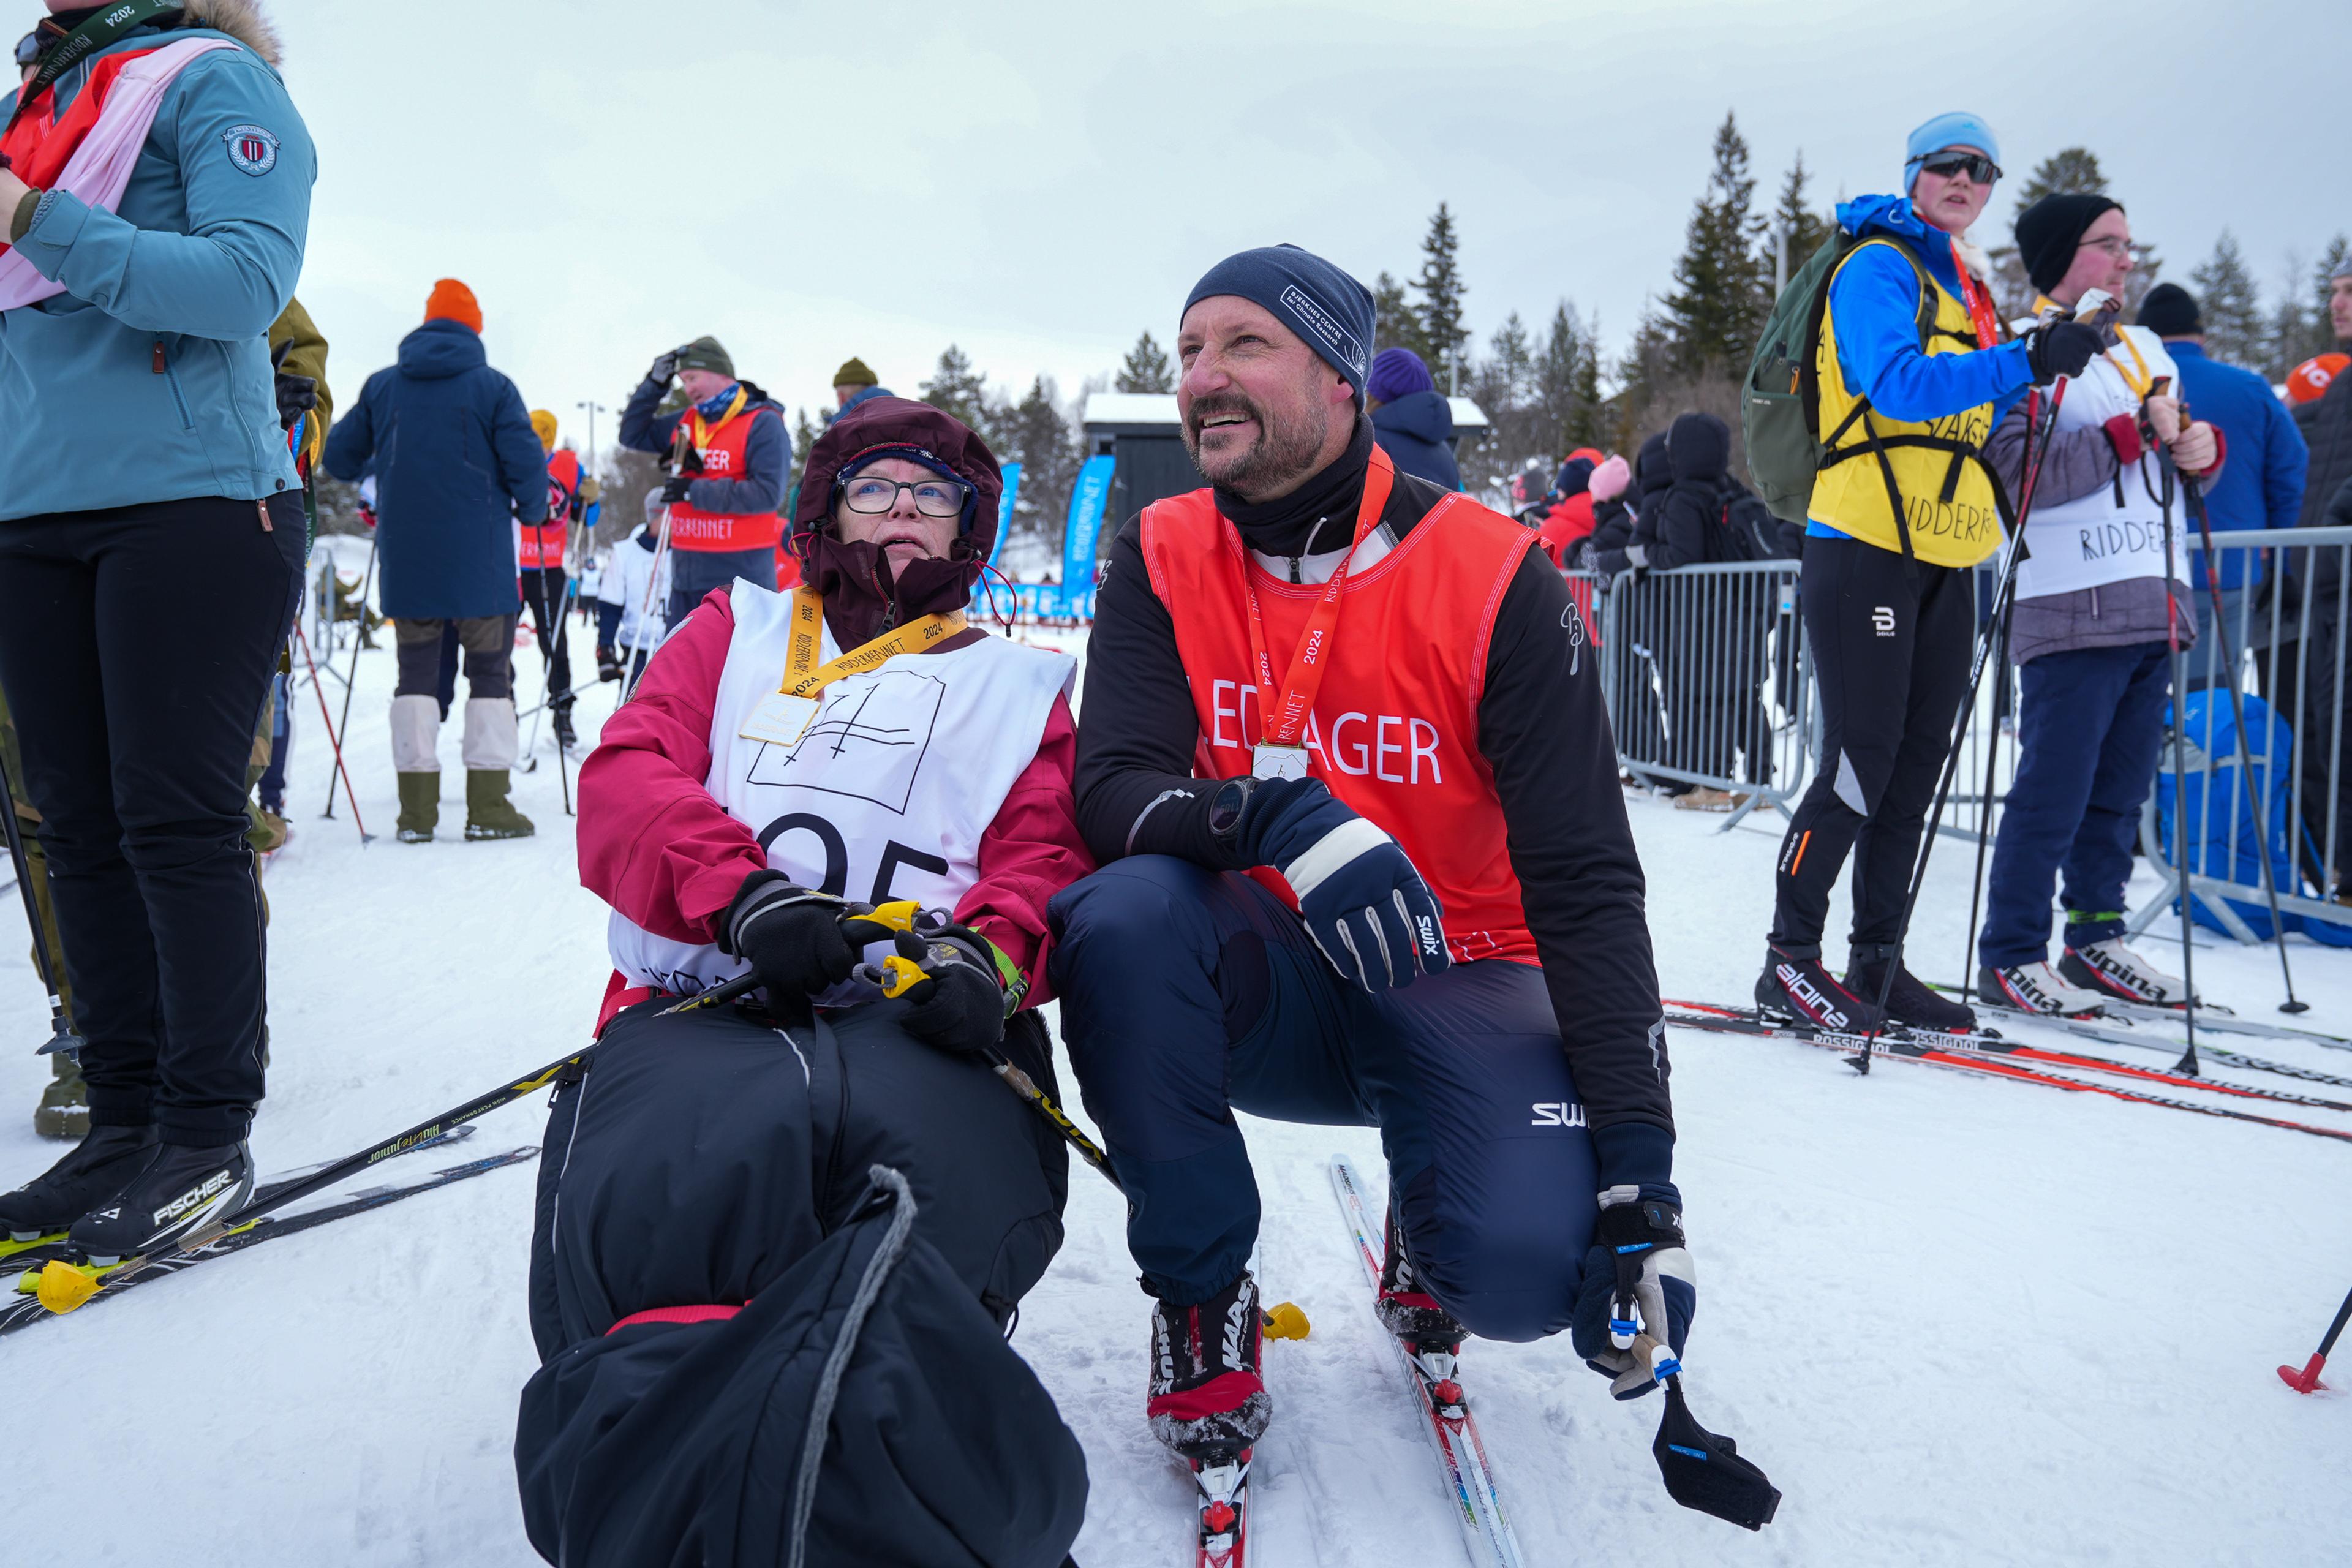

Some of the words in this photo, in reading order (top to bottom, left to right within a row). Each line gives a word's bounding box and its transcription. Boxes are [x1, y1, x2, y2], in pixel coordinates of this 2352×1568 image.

[105, 5, 136, 28] 2024
[1286, 296, 1296, 305] for
[1296, 304, 1316, 324] Climate
[1316, 323, 1338, 346] Research
[1291, 291, 1321, 320] BJERKNES
[1320, 317, 1343, 339] CENTRE
[802, 605, 813, 622] 2024
[791, 676, 820, 698] 2024
[835, 637, 906, 671] RIDDERRENNET
[923, 622, 943, 640] 2024
[1303, 630, 1324, 665] 2024
[1260, 652, 1272, 686] 2024
[1187, 676, 1442, 785] EDAGER
[1776, 963, 1849, 1028] alpina
[1910, 1031, 1980, 1050] OSSIGNOL
[451, 1103, 492, 1125] PERFORMANCE
[492, 1097, 507, 1106] HIGH
[153, 1169, 233, 1227] FISCHER
